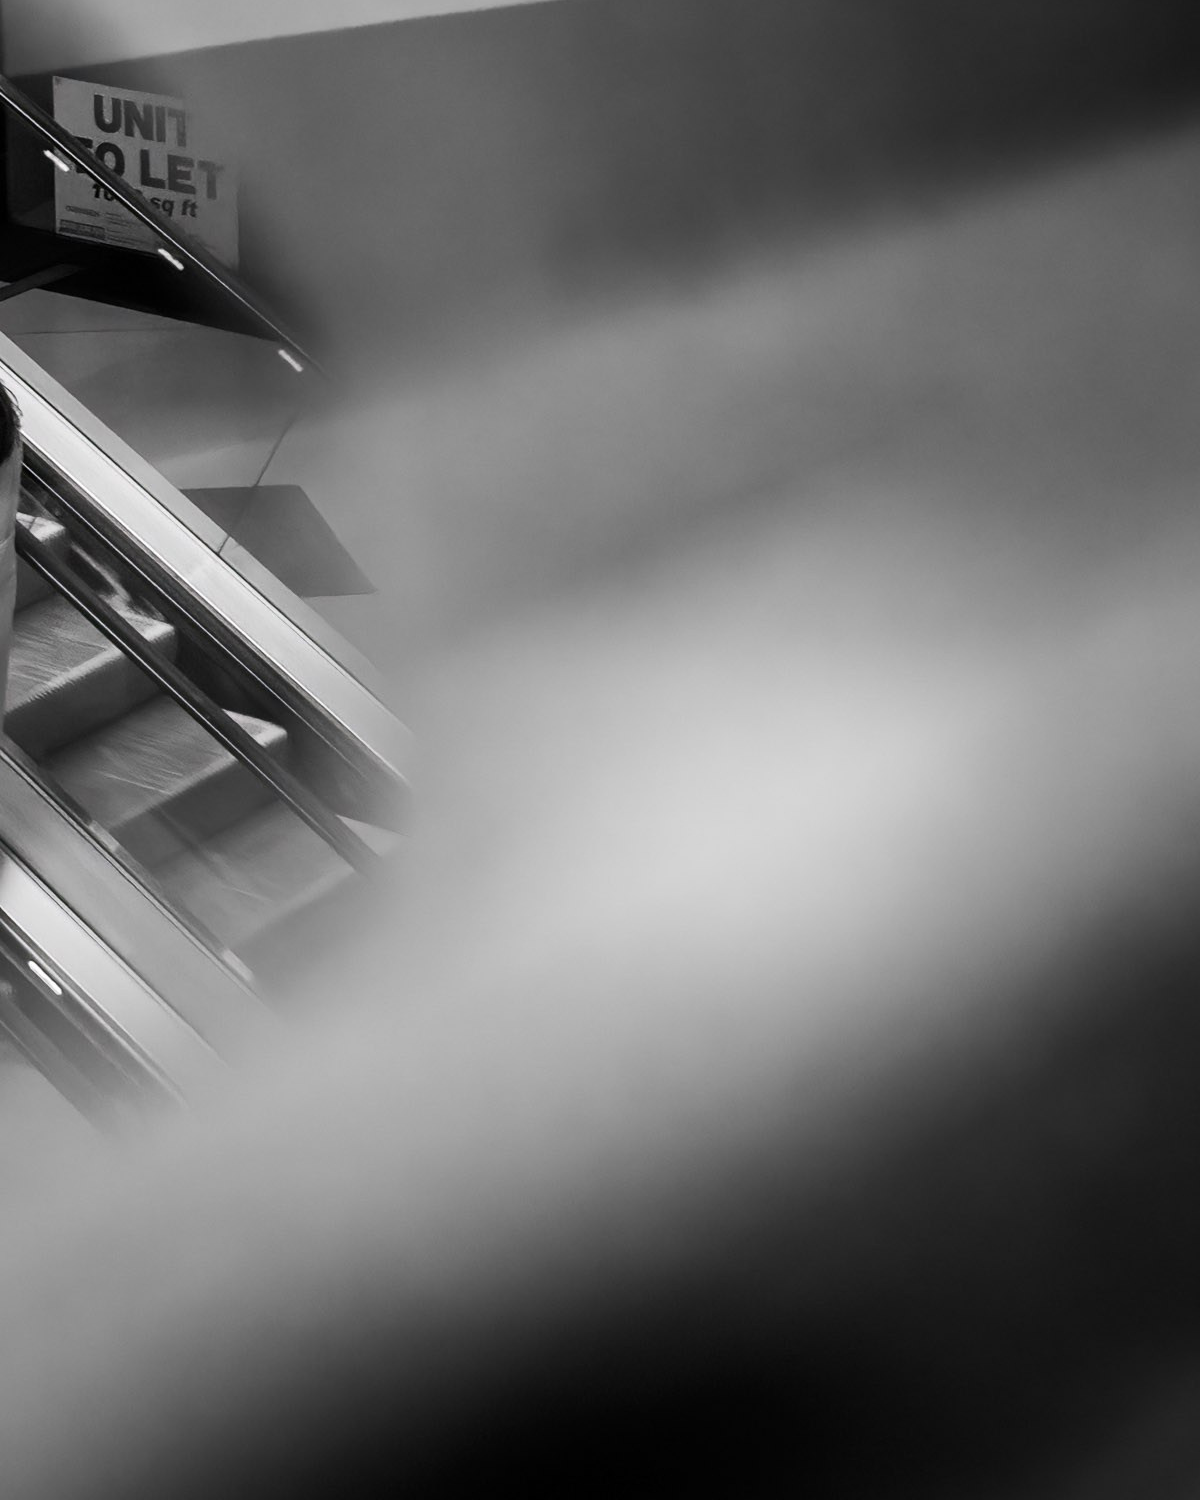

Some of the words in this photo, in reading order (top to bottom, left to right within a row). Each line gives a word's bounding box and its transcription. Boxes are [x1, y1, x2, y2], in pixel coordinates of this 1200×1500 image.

[93, 94, 187, 148] UNIT
[139, 148, 224, 201] LET
[180, 199, 199, 218] ft
